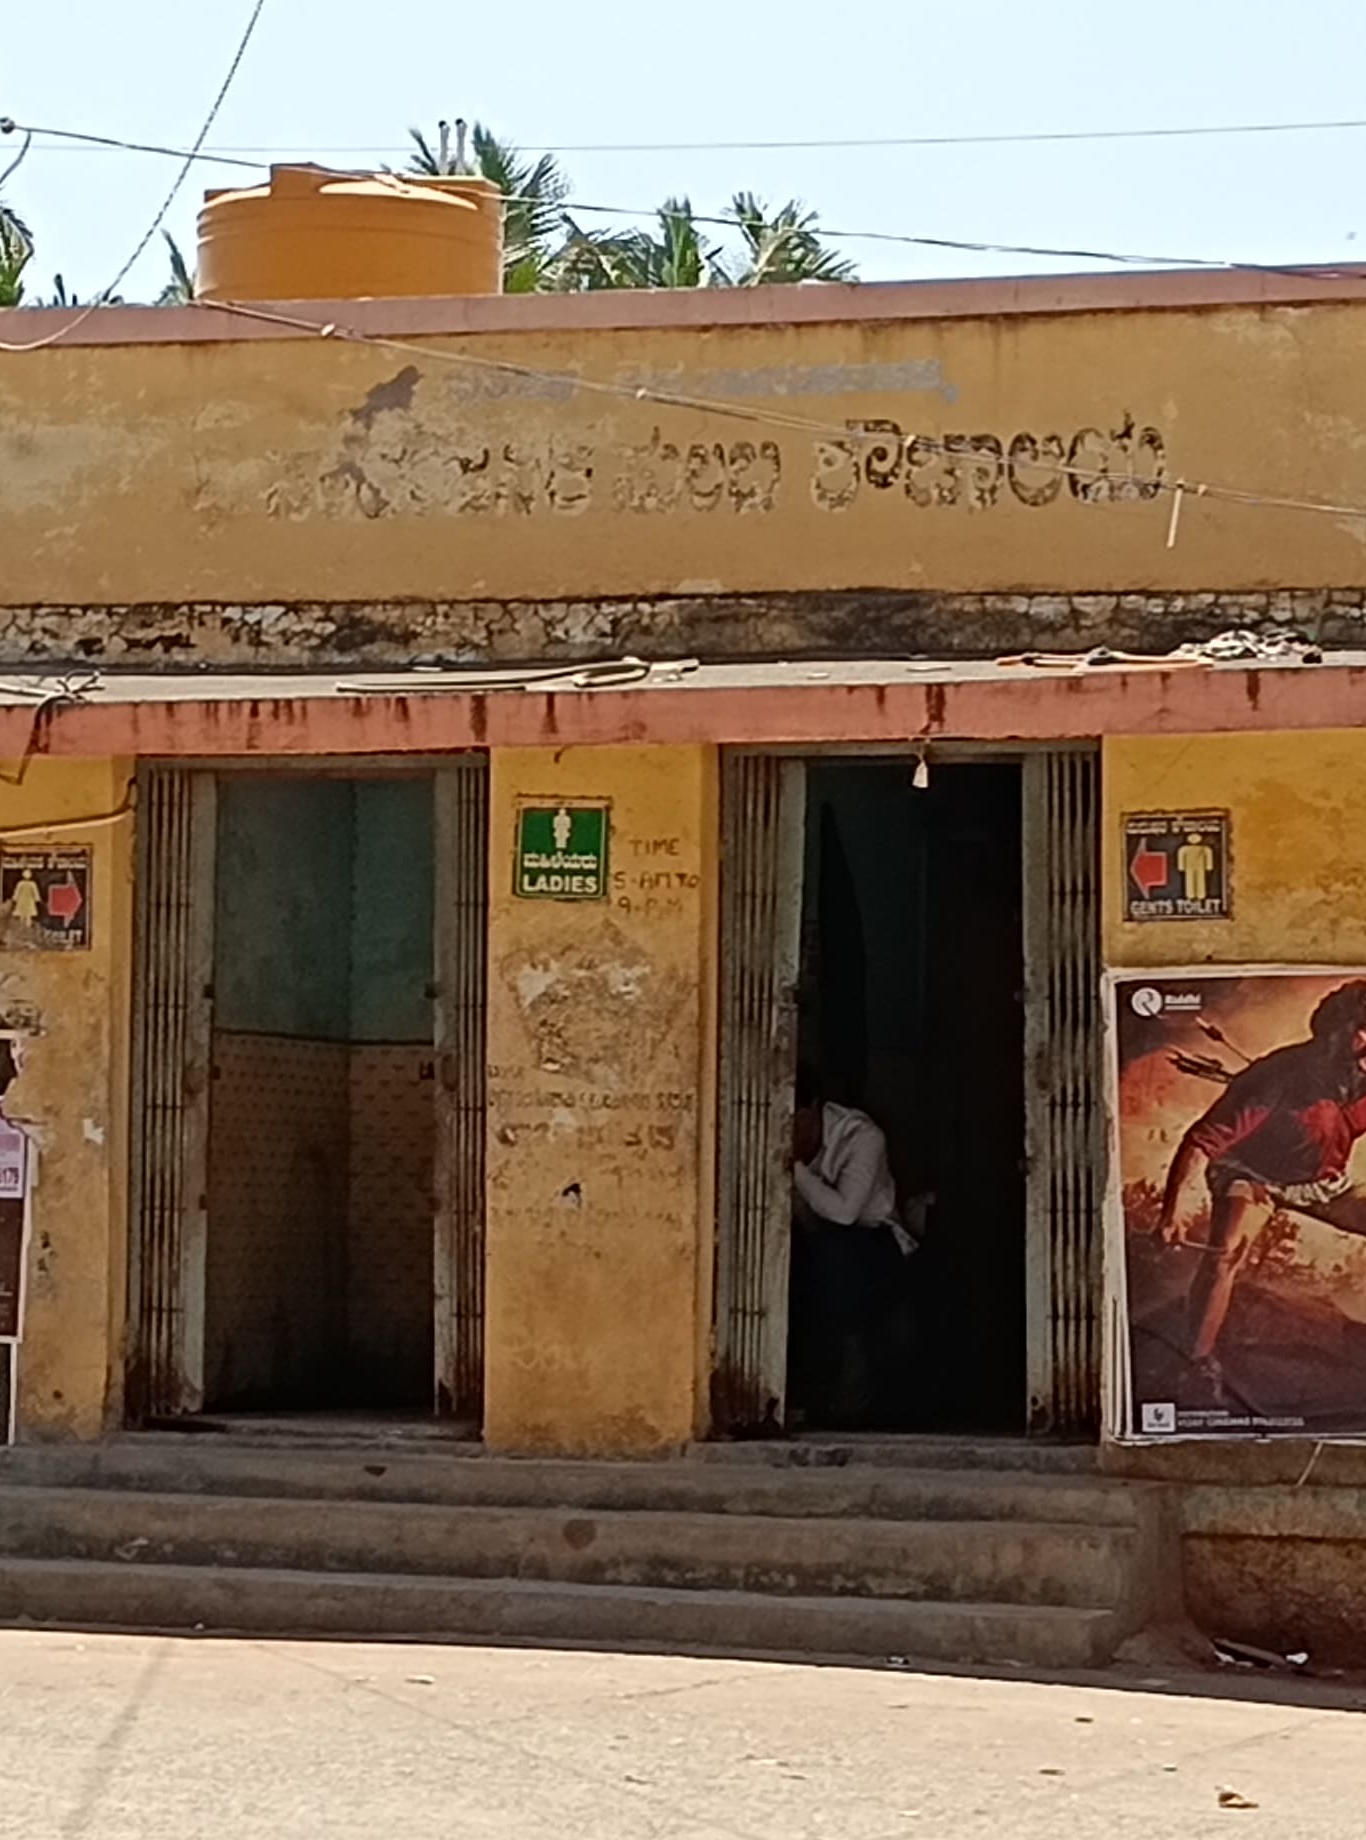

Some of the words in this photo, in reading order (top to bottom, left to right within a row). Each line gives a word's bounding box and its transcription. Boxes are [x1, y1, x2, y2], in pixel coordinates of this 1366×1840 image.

[628, 838, 680, 856] TIME
[522, 875, 598, 893] LADIES
[1176, 899, 1221, 913] TOILET
